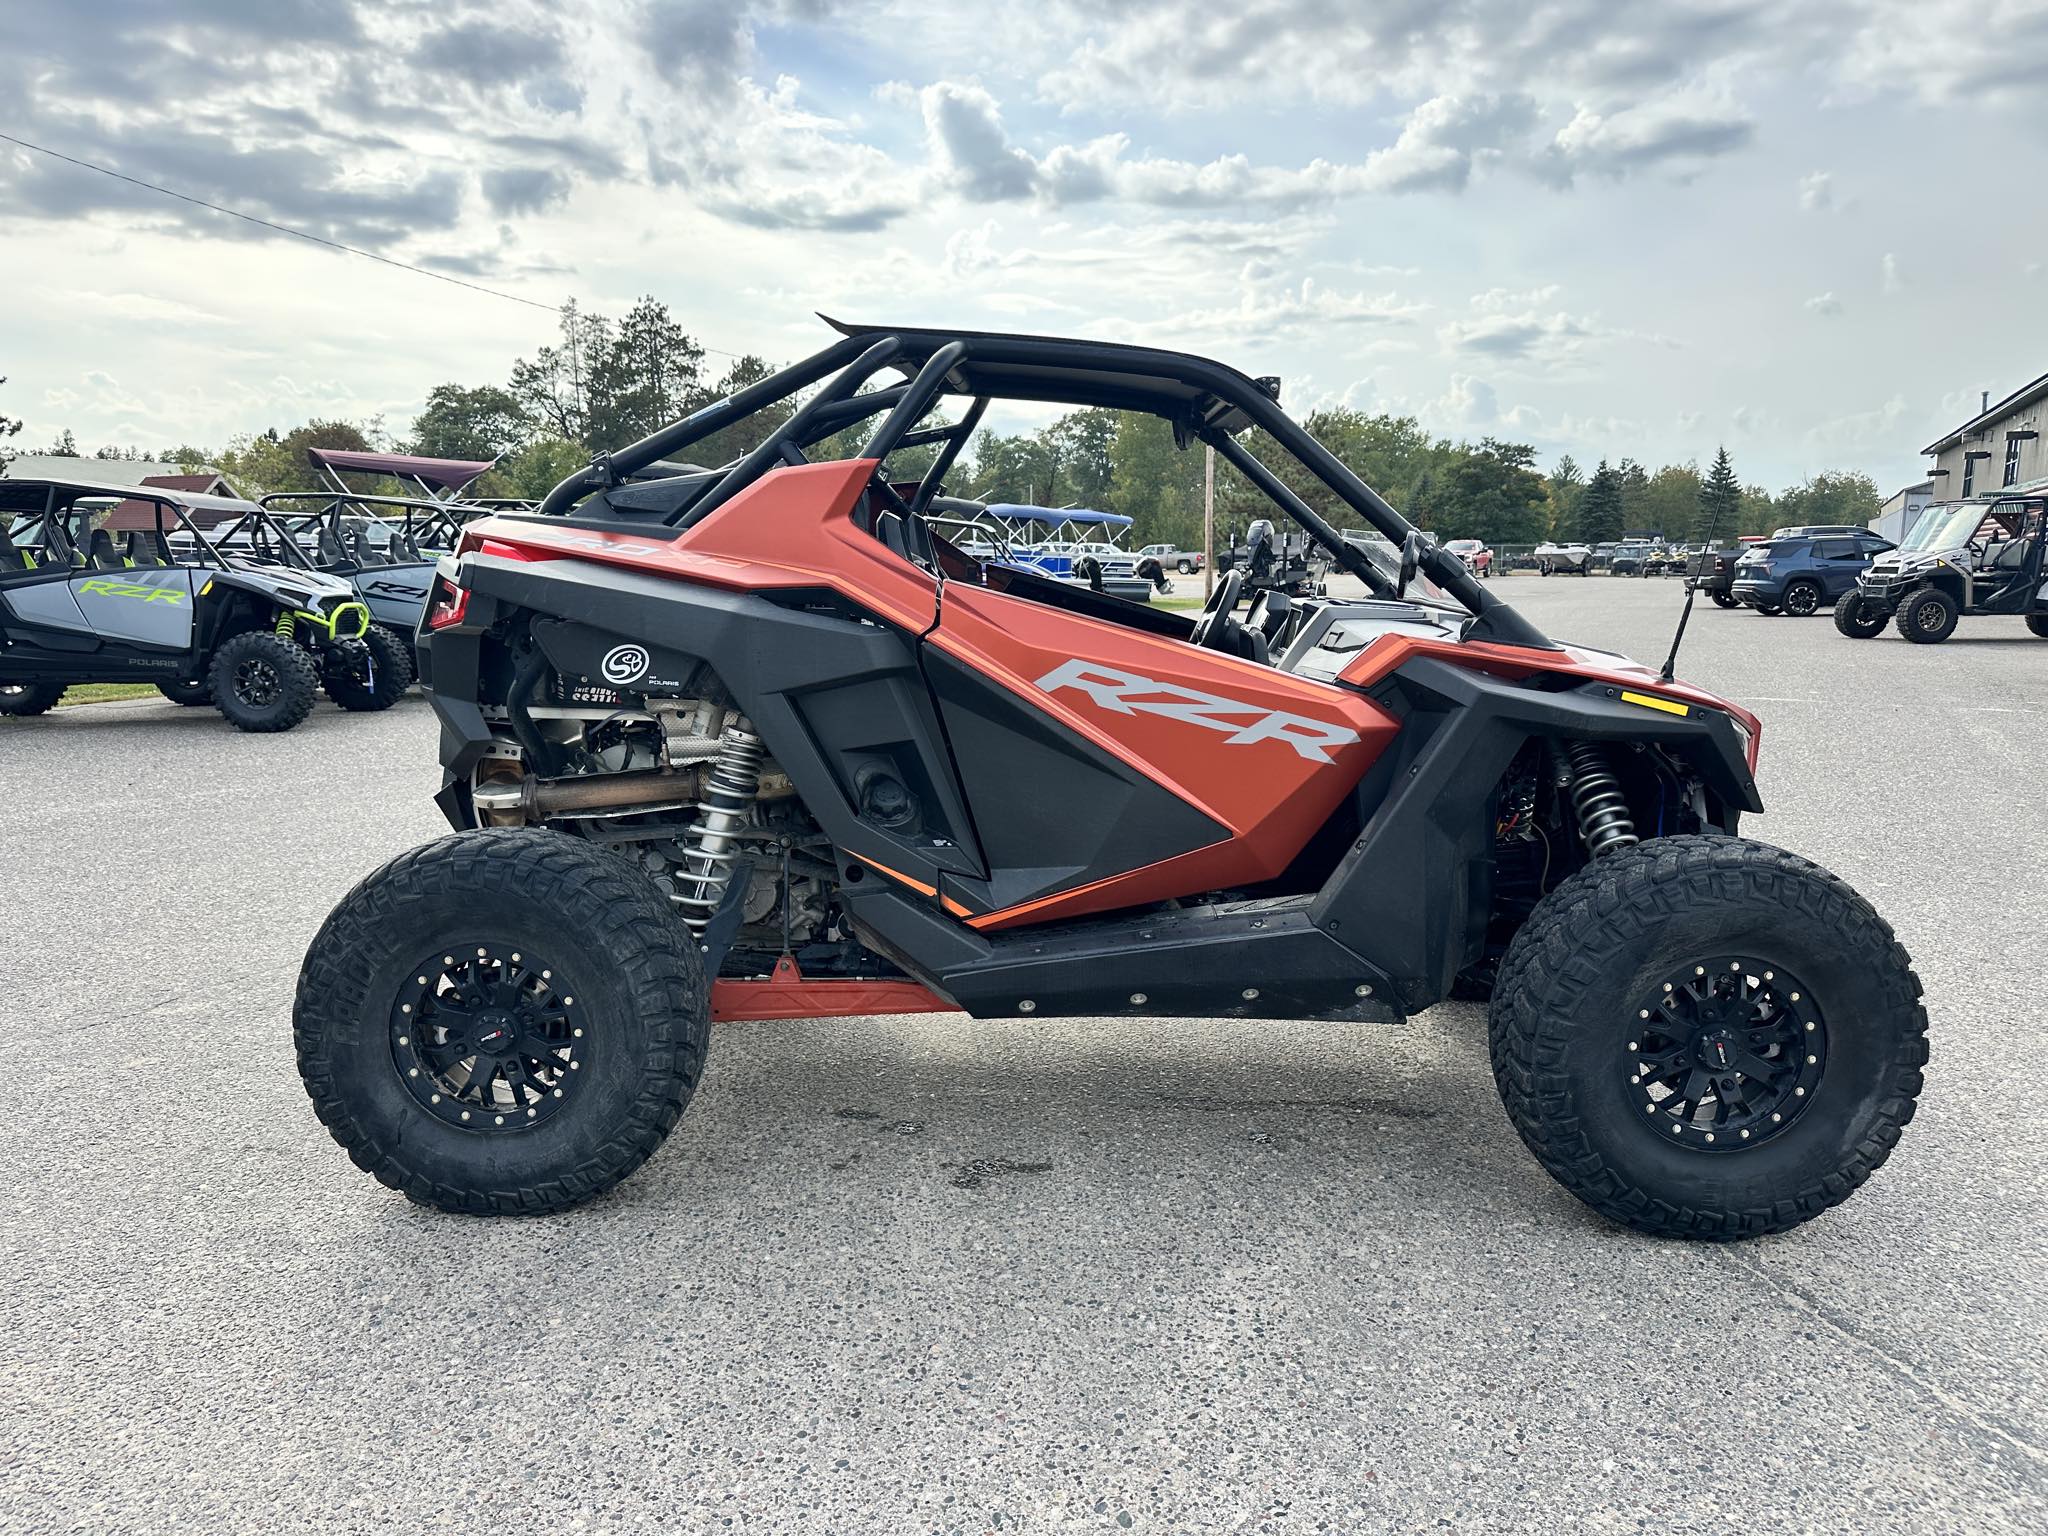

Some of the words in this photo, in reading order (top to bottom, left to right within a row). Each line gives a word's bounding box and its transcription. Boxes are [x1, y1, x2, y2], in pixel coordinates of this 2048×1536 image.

[78, 581, 186, 605] RZR
[366, 581, 428, 598] RZ
[128, 658, 178, 668] POLARIS
[648, 679, 680, 687] POLARIS
[1032, 658, 1361, 765] RZR
